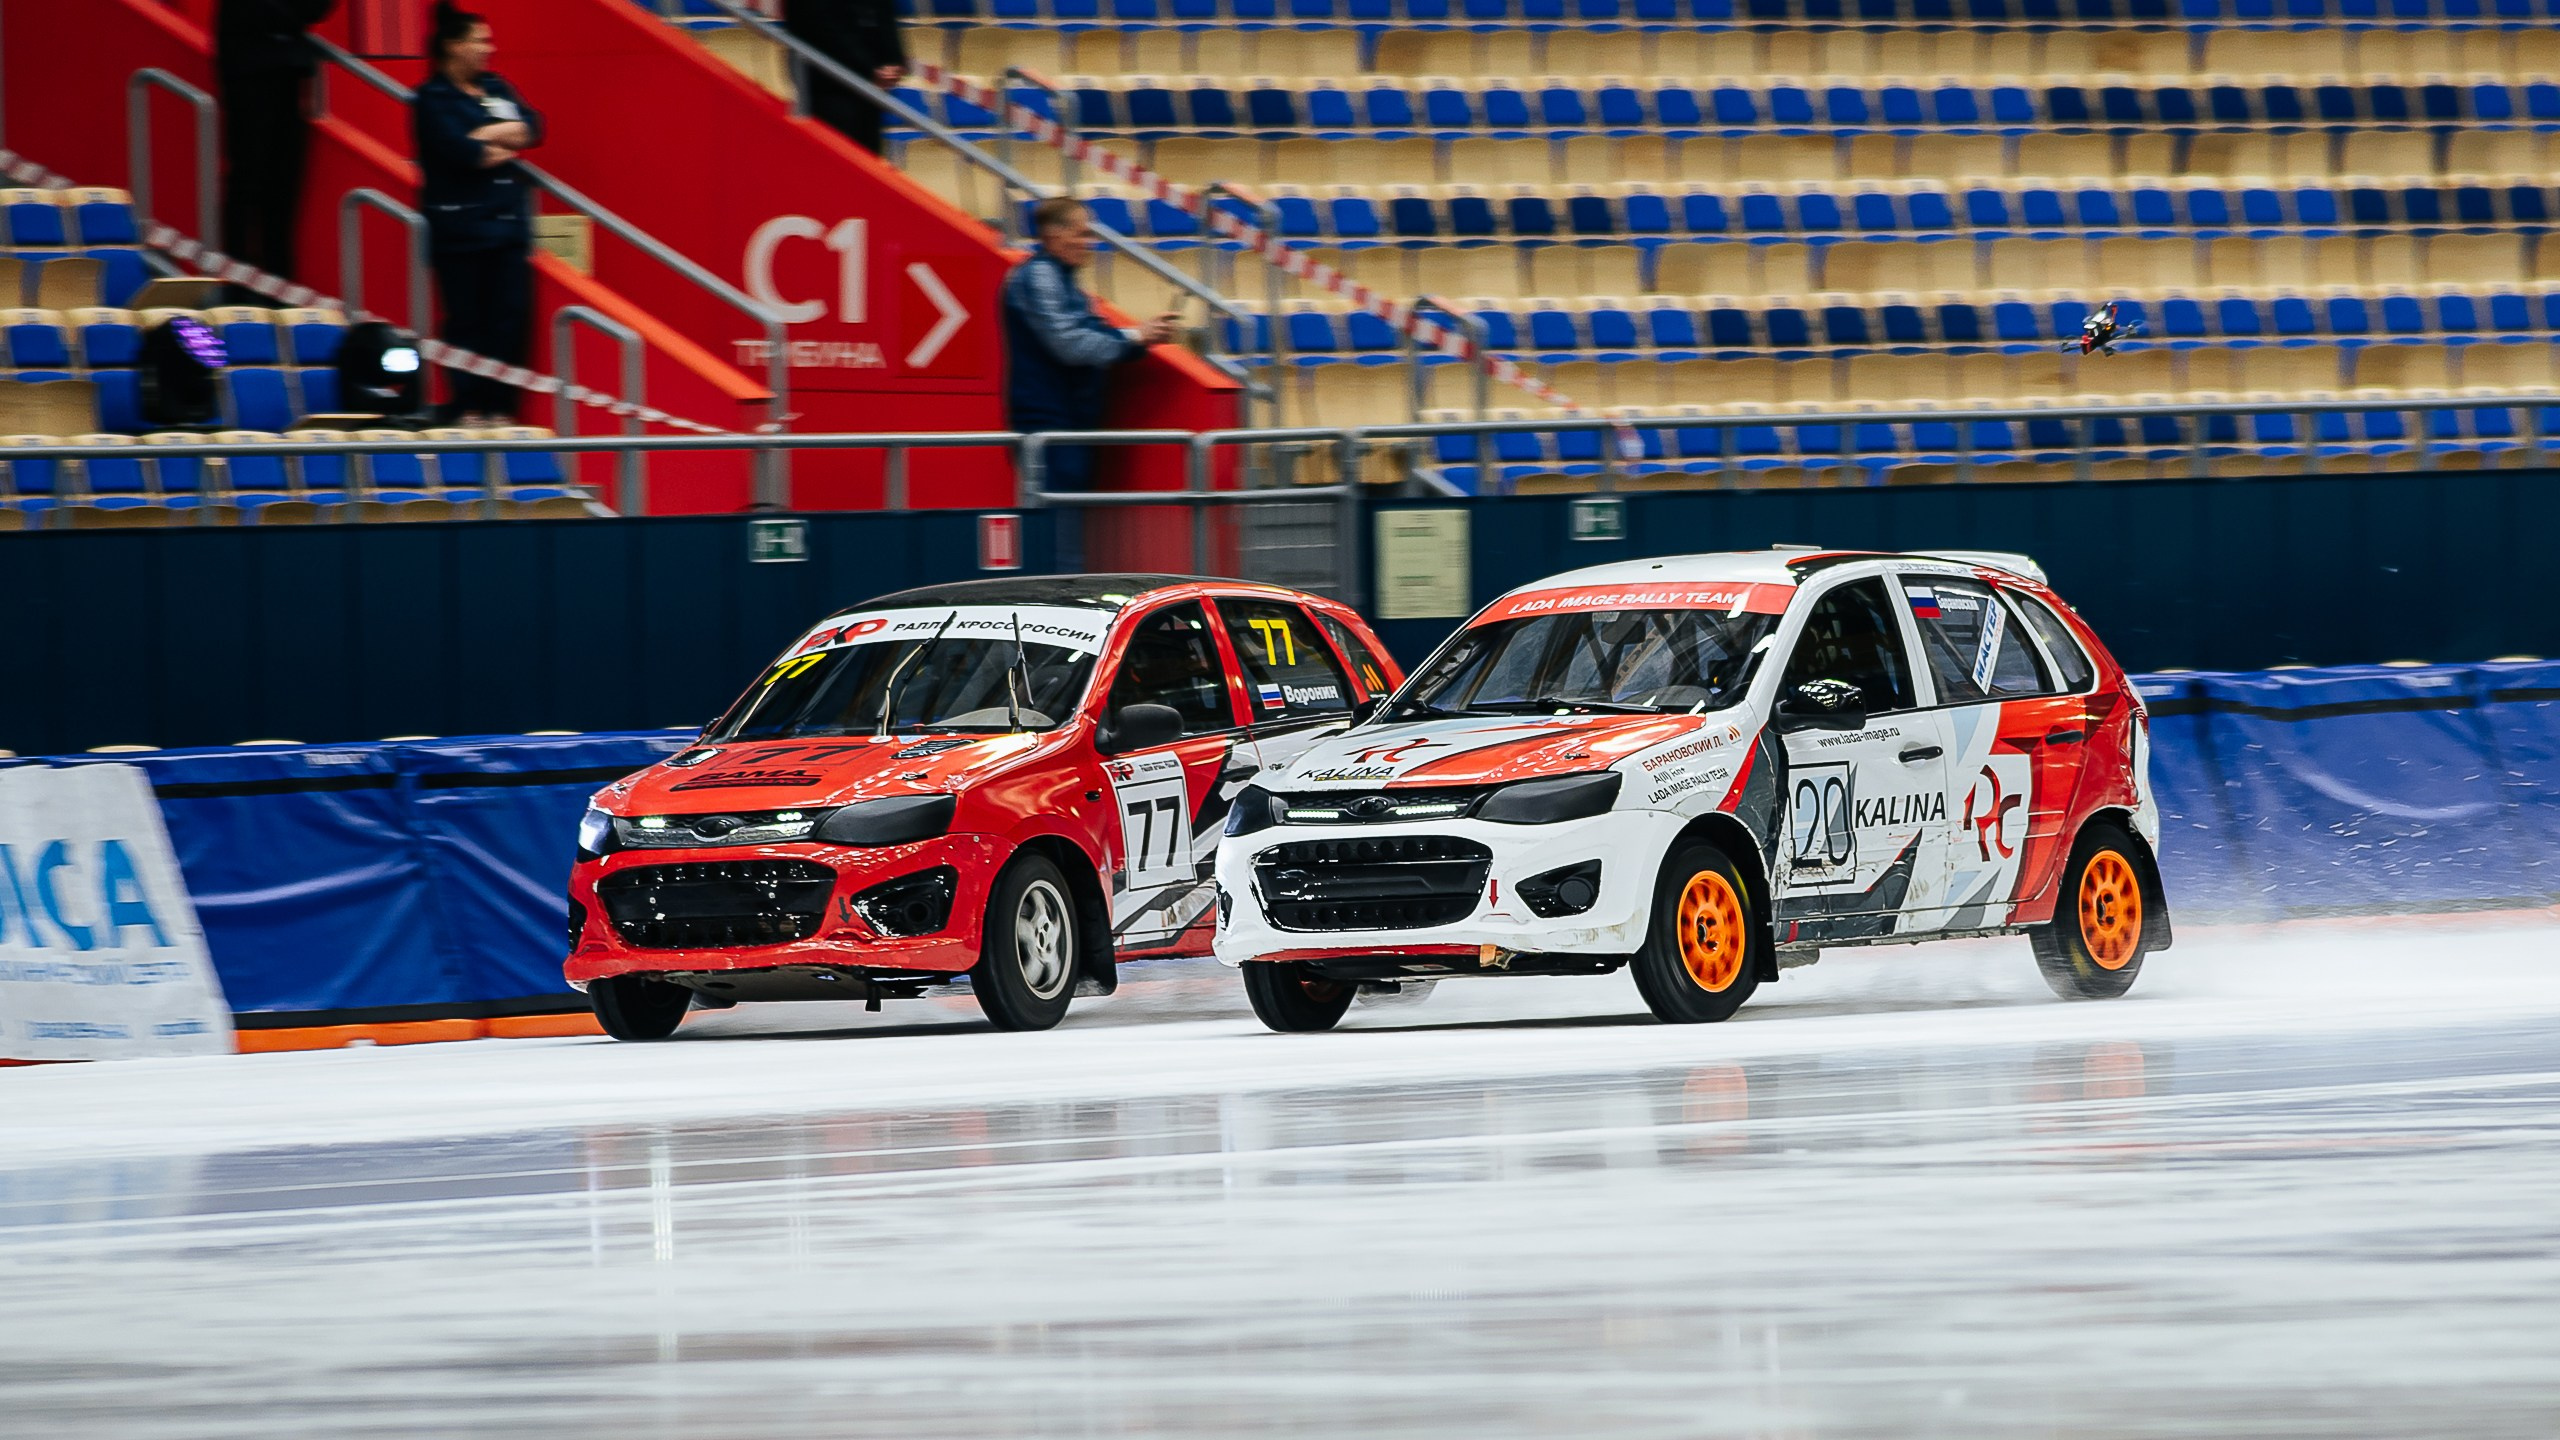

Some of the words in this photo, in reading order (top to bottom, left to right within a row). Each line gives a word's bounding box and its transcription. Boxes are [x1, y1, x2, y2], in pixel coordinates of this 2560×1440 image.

[731, 338, 888, 369] ТРБУНА
[1507, 600, 1555, 615] LADA
[1557, 594, 1619, 609] IMAGE
[1619, 592, 1683, 604] RALLY
[1684, 592, 1742, 605] TEAM
[1020, 623, 1097, 642] РОССИИ
[1248, 619, 1296, 666] 77
[1975, 597, 1998, 685] МАСТЕР
[764, 652, 827, 686] 77
[1282, 685, 1340, 705] Воронин
[1642, 737, 1713, 772] БАРАНОВСКИЙ
[1817, 727, 1901, 748] www.lada-image.ru
[740, 745, 869, 765] 77
[1297, 766, 1396, 779] KALINA
[1648, 788, 1672, 804] LADA
[1669, 779, 1694, 795] IMAGE
[1692, 773, 1711, 787] RALLY
[1709, 767, 1730, 781] TEAM
[1790, 777, 1852, 869] 20
[1855, 792, 1946, 829] KALINA
[1126, 795, 1181, 873] 77
